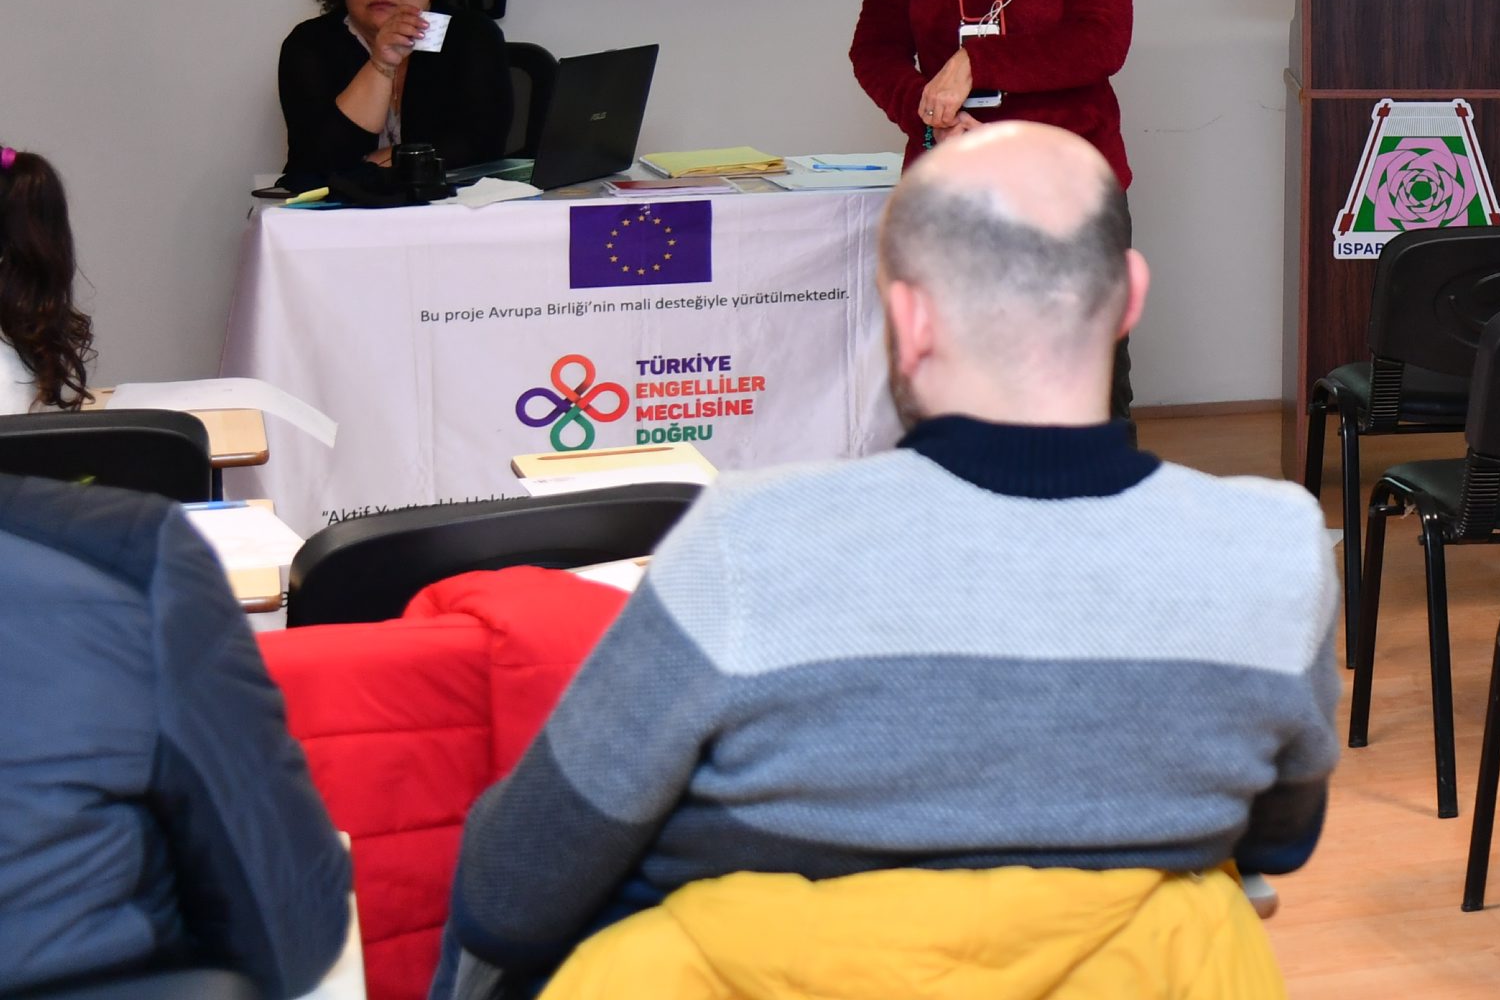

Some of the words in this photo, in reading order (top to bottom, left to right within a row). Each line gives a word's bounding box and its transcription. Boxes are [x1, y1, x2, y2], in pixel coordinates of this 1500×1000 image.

[1338, 242, 1385, 256] ISPAR
[420, 310, 440, 322] Bu
[444, 307, 484, 324] proje
[489, 306, 542, 320] Avrupa
[547, 301, 616, 317] Birliği’nin
[620, 298, 651, 313] mali
[655, 295, 728, 311] desteğiyle
[732, 288, 850, 309] yürütülmektedir.
[636, 353, 732, 376] TÜRKİYE
[636, 374, 766, 399] ENGELLİLER
[636, 397, 754, 422] MECLİSİNE
[636, 422, 713, 445] DOĞRU
